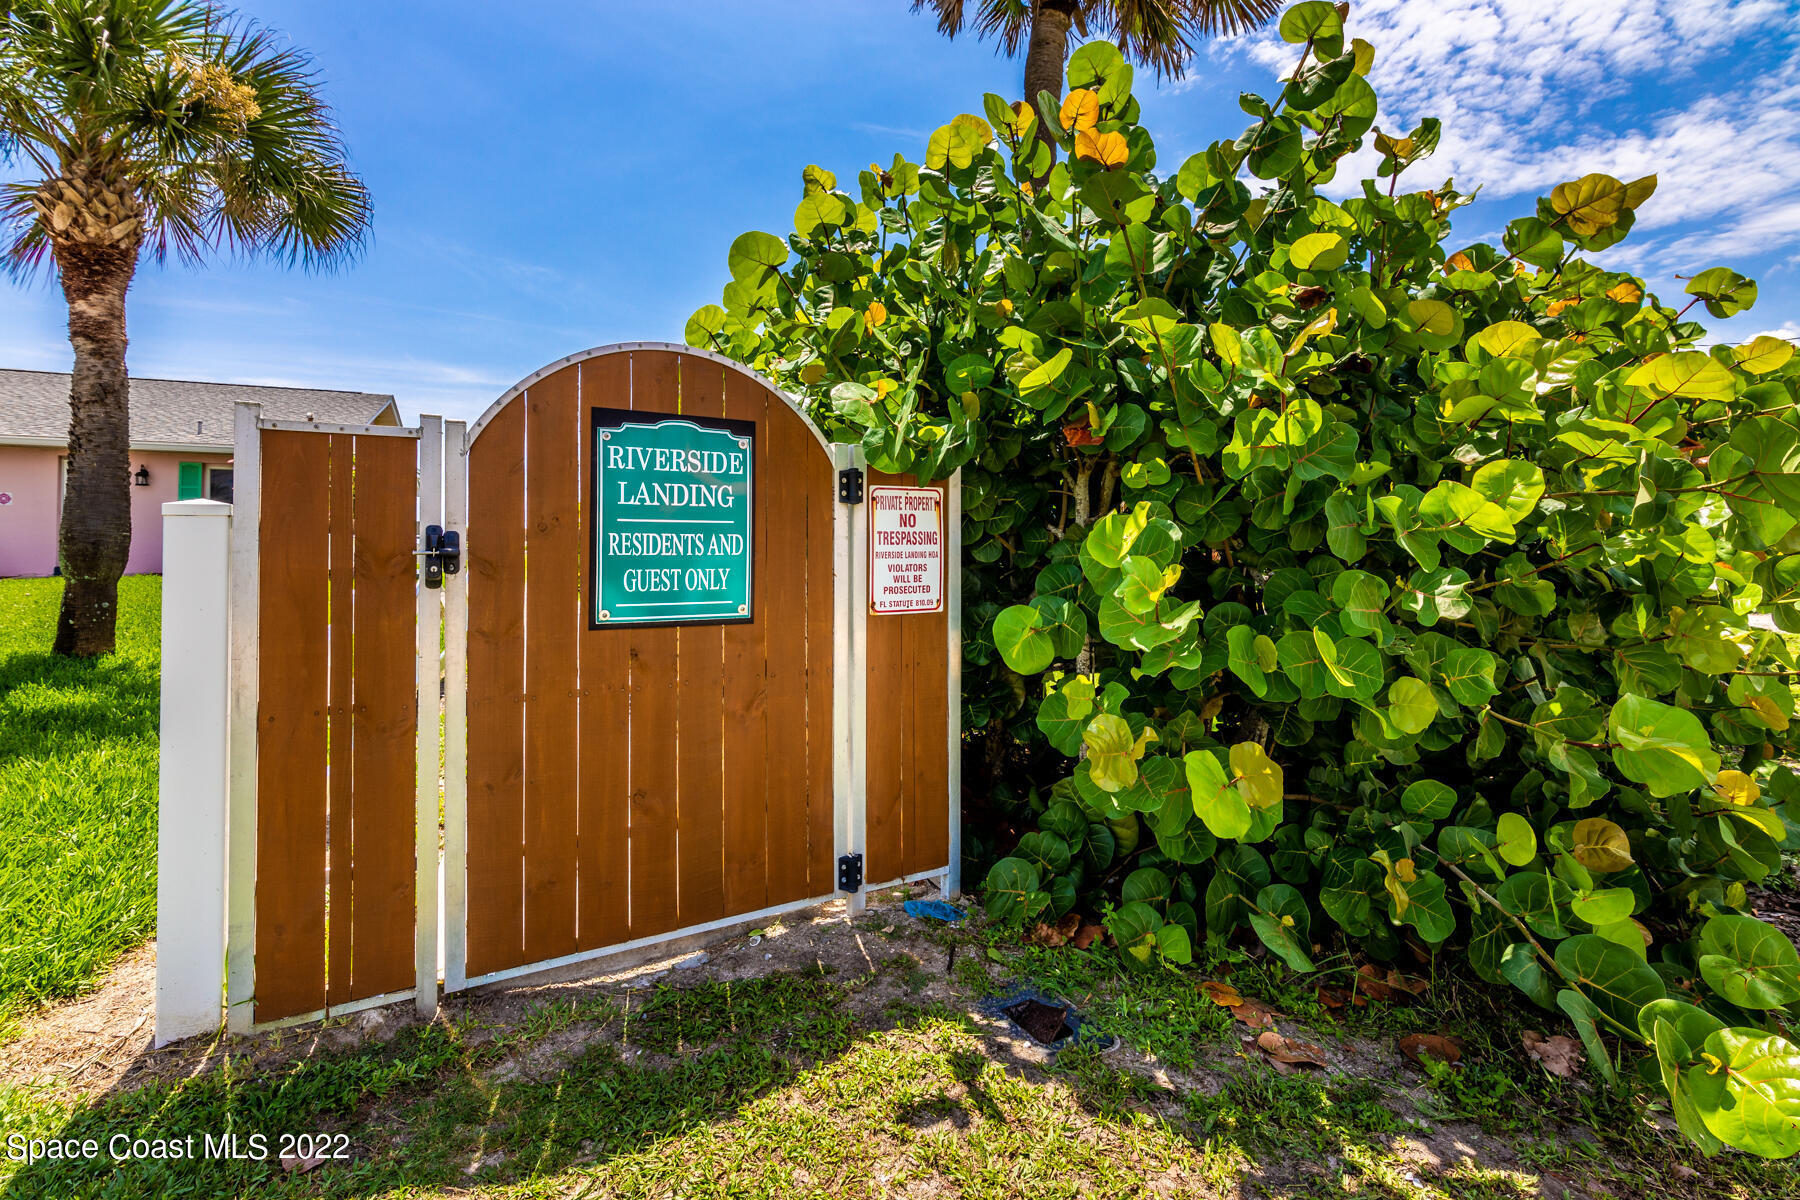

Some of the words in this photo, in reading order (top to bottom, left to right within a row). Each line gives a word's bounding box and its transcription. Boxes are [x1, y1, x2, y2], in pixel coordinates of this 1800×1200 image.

[607, 445, 744, 475] RIVERSIDE
[617, 481, 735, 508] LANDING
[875, 495, 902, 511] PRIVATE
[904, 496, 938, 511] PROPERTY
[899, 513, 917, 528] NO
[607, 532, 704, 556] RESIDENTS
[707, 533, 743, 556] AND
[877, 530, 938, 546] TRESPASSING
[875, 551, 904, 559] RIVERSIDE
[904, 551, 927, 559] LANDING
[928, 551, 938, 559] HOA
[887, 563, 928, 573] VIOLATORS
[623, 568, 681, 592] GUEST
[685, 568, 730, 591] ONLY
[893, 575, 911, 583] WILL
[913, 574, 923, 583] BE
[883, 585, 931, 595] PROSECUTED
[879, 600, 887, 608] FL
[889, 599, 914, 608] STATUTE
[915, 598, 934, 607] 810.09
